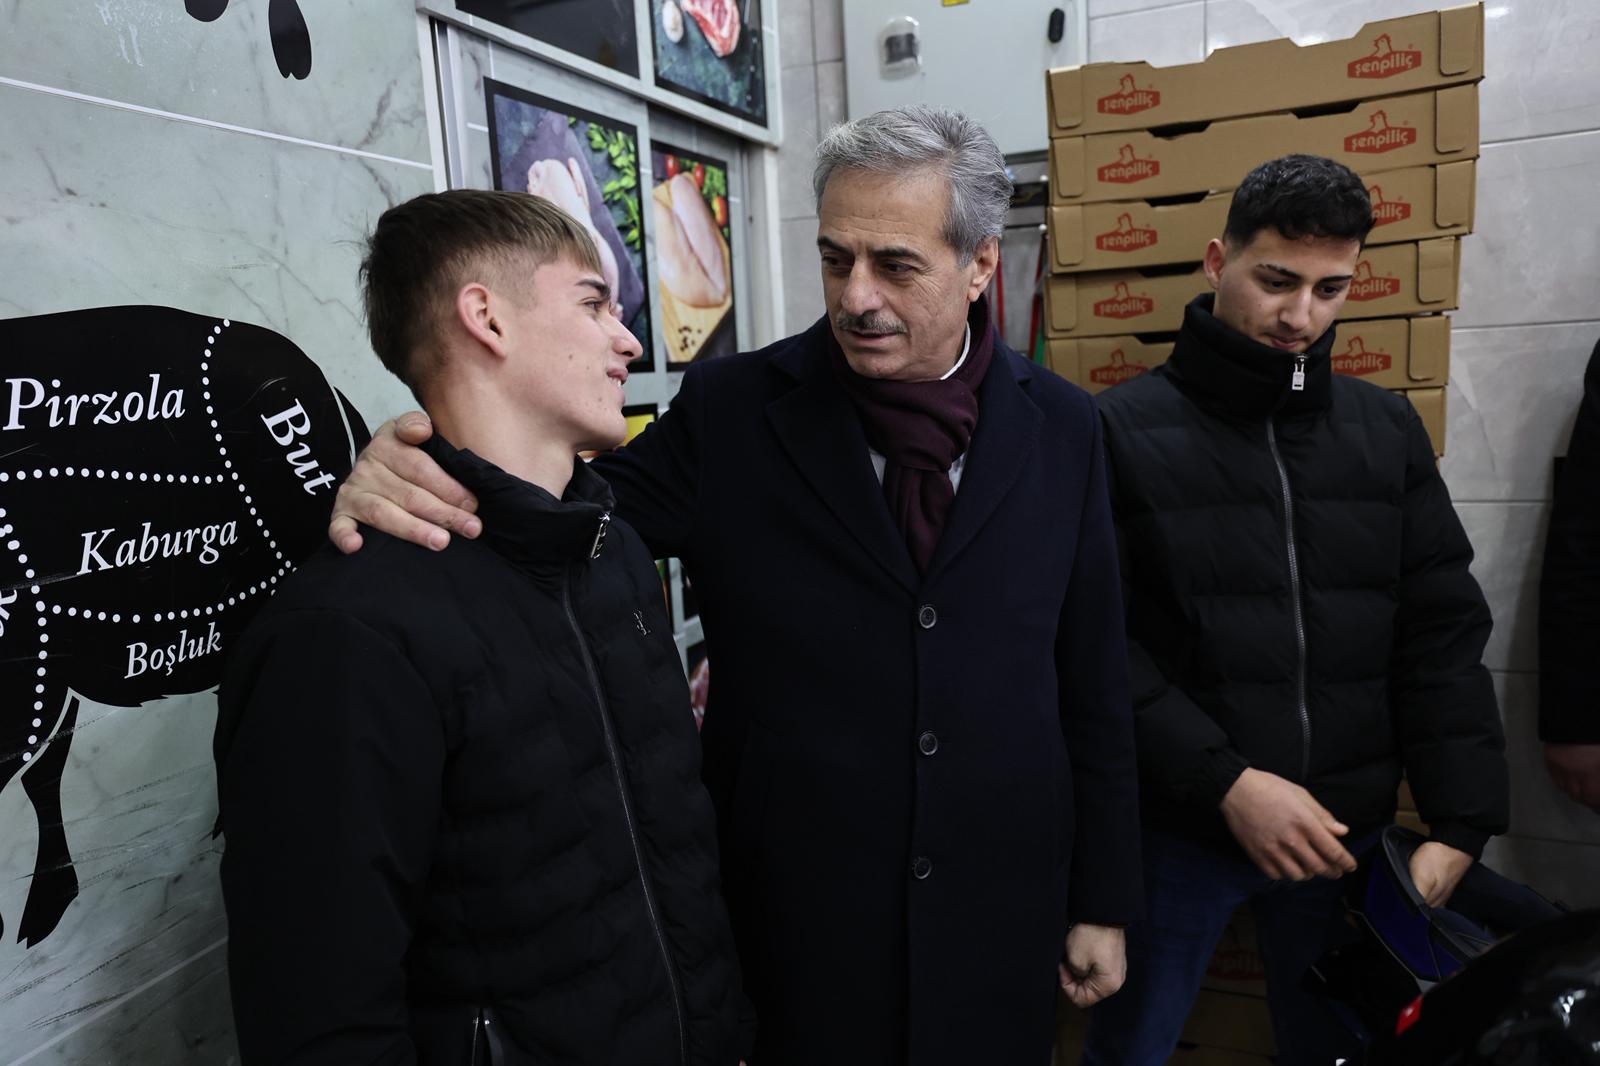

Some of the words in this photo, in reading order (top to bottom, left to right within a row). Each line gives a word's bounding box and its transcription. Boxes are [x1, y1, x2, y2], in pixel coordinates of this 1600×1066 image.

[1355, 53, 1413, 77] şenpiliç
[1352, 130, 1408, 152] şenpiliç
[1371, 203, 1402, 220] piliç
[1351, 280, 1392, 297] npiliç
[3, 374, 186, 430] Pirzola
[261, 398, 335, 495] But
[76, 521, 238, 575] Kaburga
[124, 622, 222, 679] Boşluk
